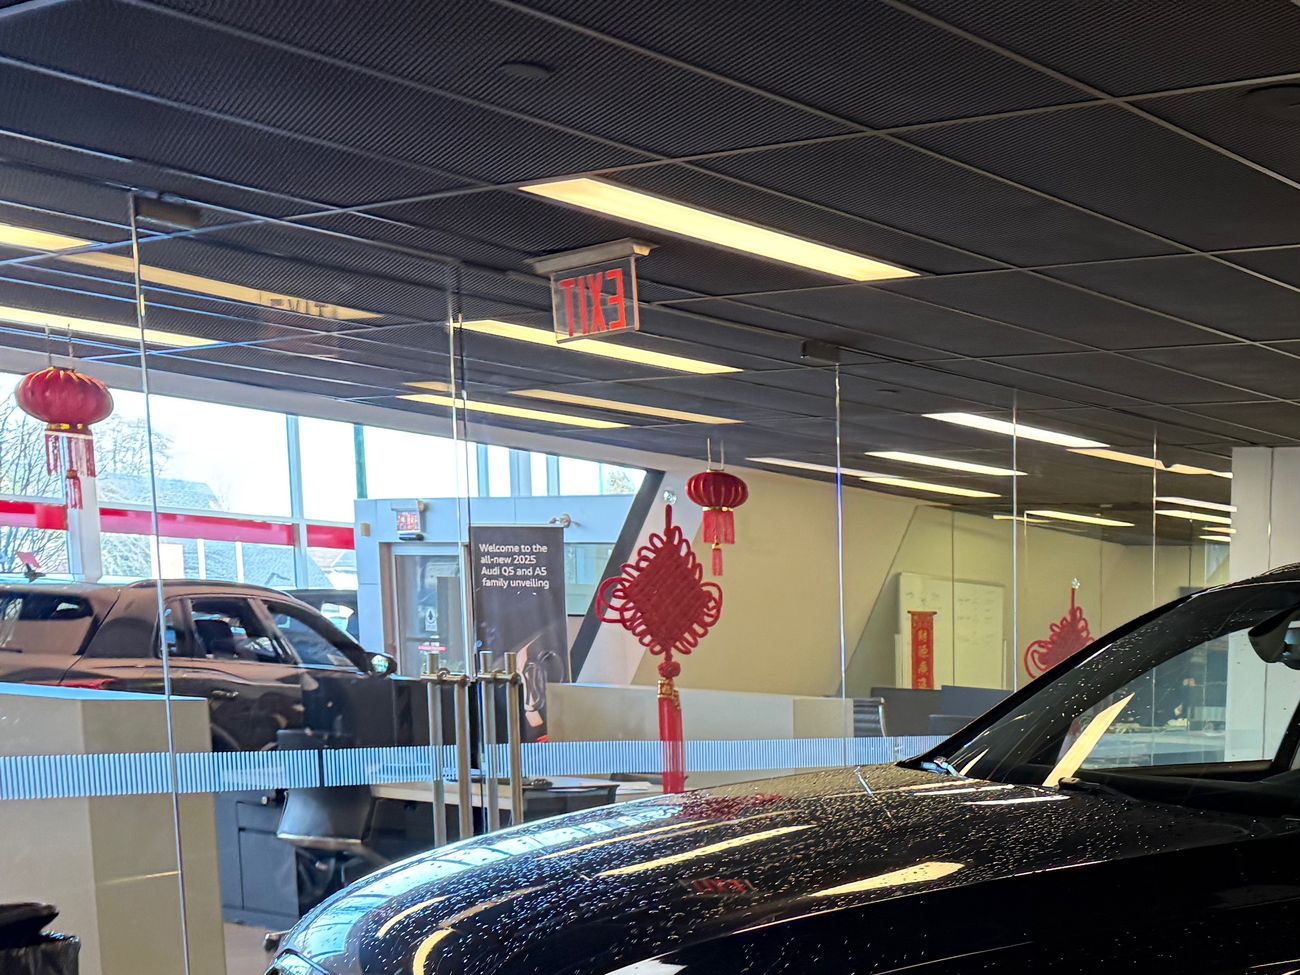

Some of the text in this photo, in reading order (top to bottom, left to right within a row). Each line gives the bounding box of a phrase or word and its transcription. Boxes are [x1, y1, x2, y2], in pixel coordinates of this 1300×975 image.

[479, 543, 548, 553] Welcome to the
[480, 555, 537, 564] all-new 2025
[481, 566, 548, 576] Audi Q5 and A5
[482, 577, 550, 590] family unveiling
